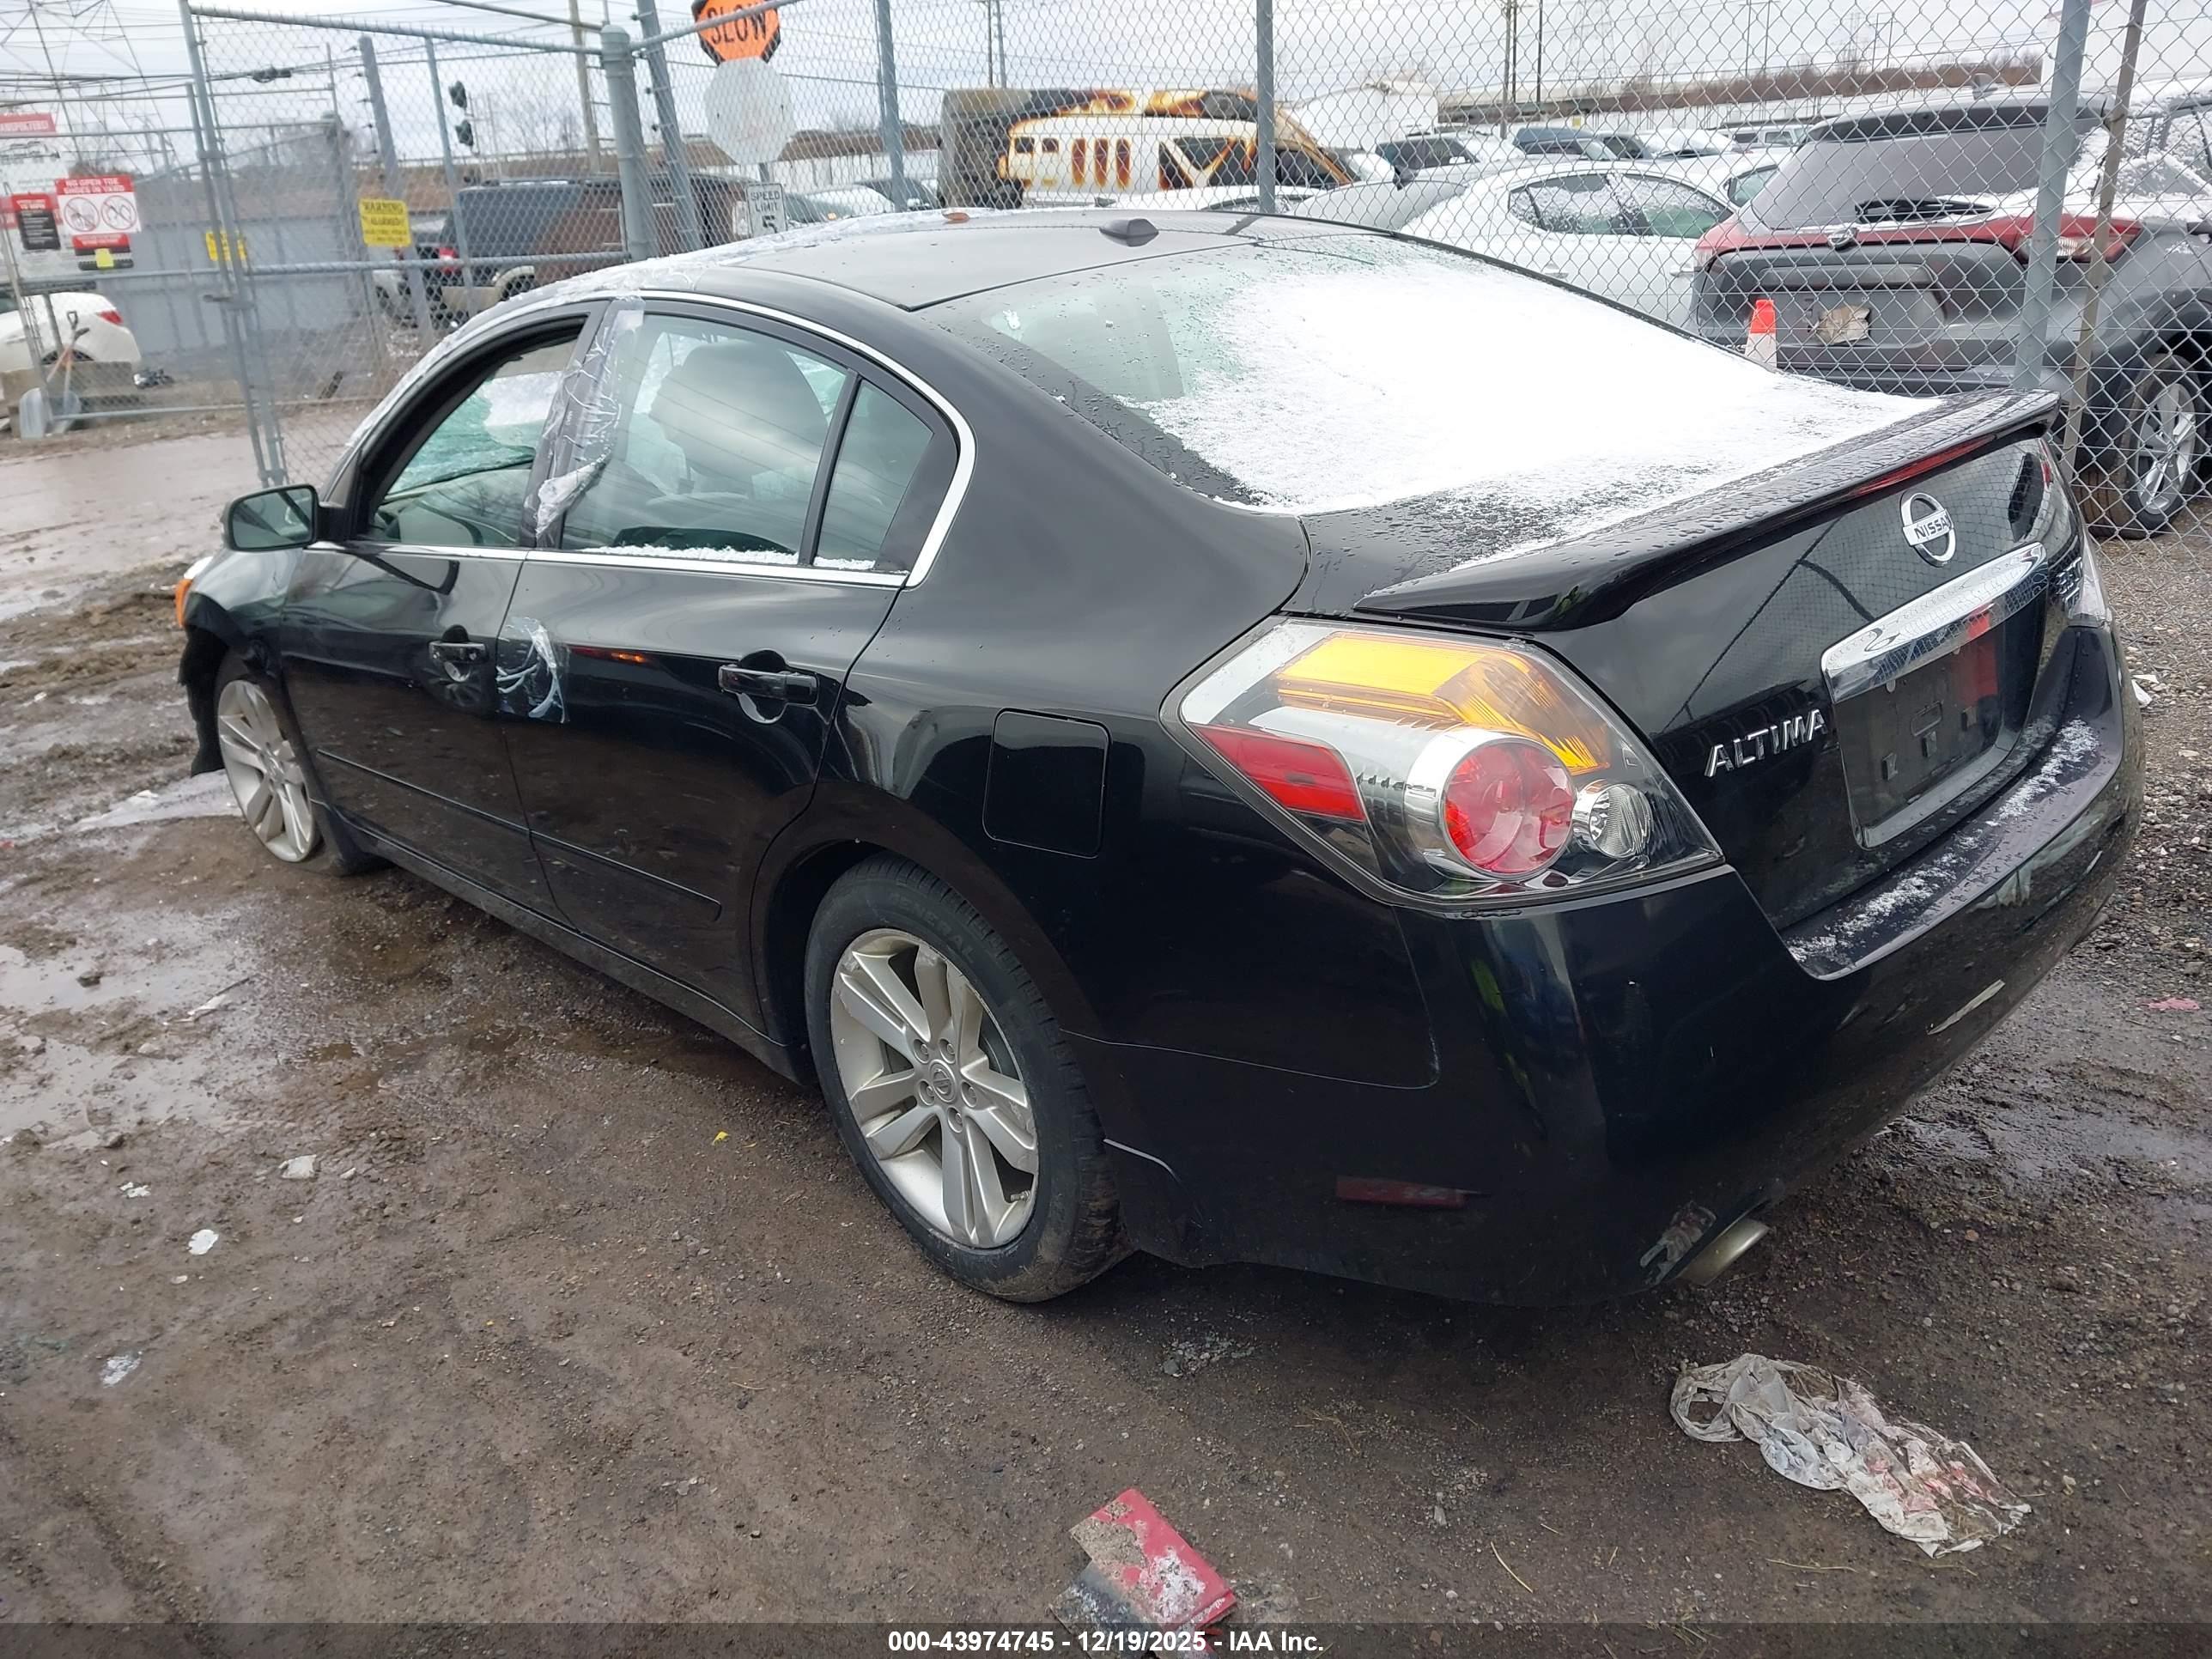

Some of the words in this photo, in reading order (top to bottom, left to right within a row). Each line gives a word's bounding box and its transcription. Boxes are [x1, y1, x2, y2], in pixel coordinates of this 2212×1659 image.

[707, 3, 767, 44] SLOW
[750, 191, 780, 201] SPEED
[755, 201, 778, 212] LIMIT
[1704, 708, 1828, 777] ALTIMA
